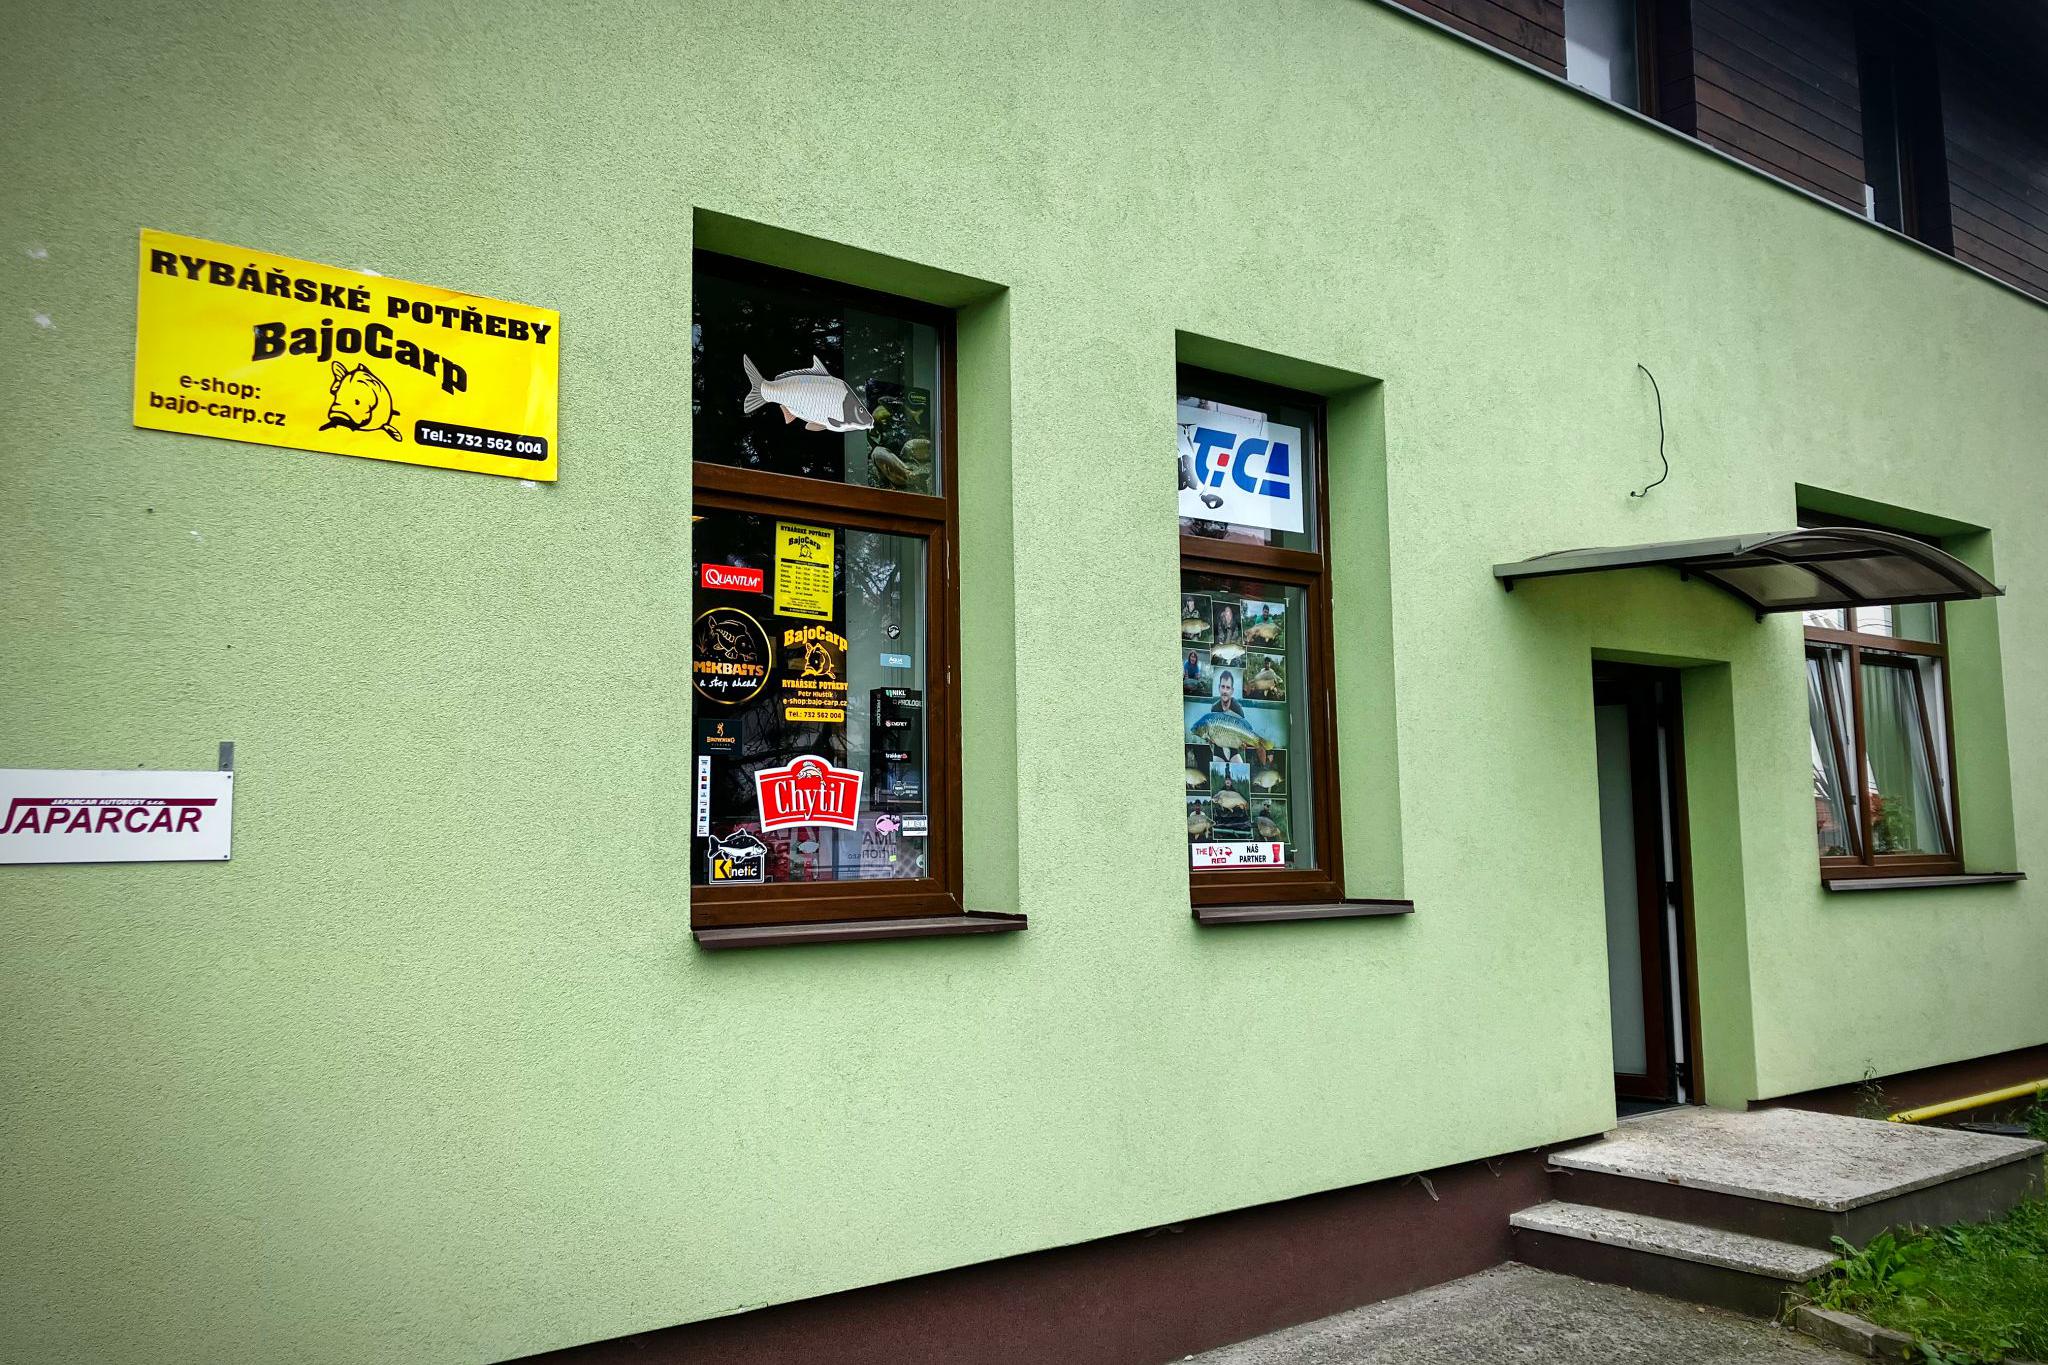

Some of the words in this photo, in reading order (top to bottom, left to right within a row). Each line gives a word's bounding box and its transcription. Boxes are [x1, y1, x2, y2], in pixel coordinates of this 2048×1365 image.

[151, 249, 371, 313] RYBÁŘSKÉ
[387, 296, 551, 344] POTŘEBY
[253, 318, 468, 395] BajoCarp
[180, 375, 261, 399] e-shop:
[150, 391, 286, 426] bajo-carp.cz
[421, 427, 453, 443] Tel.:
[456, 432, 482, 447] 732
[487, 437, 512, 451] 562
[516, 441, 542, 454] 004
[789, 536, 821, 550] BajoCarp
[784, 625, 848, 652] BajoCarp
[700, 679, 706, 687] a
[709, 676, 728, 692] step
[732, 678, 757, 688] ahead
[775, 779, 846, 821] Chytil
[0, 799, 203, 834] JAPARCAR
[1239, 854, 1266, 863] PARTNER
[1246, 844, 1259, 853] NÁŠ
